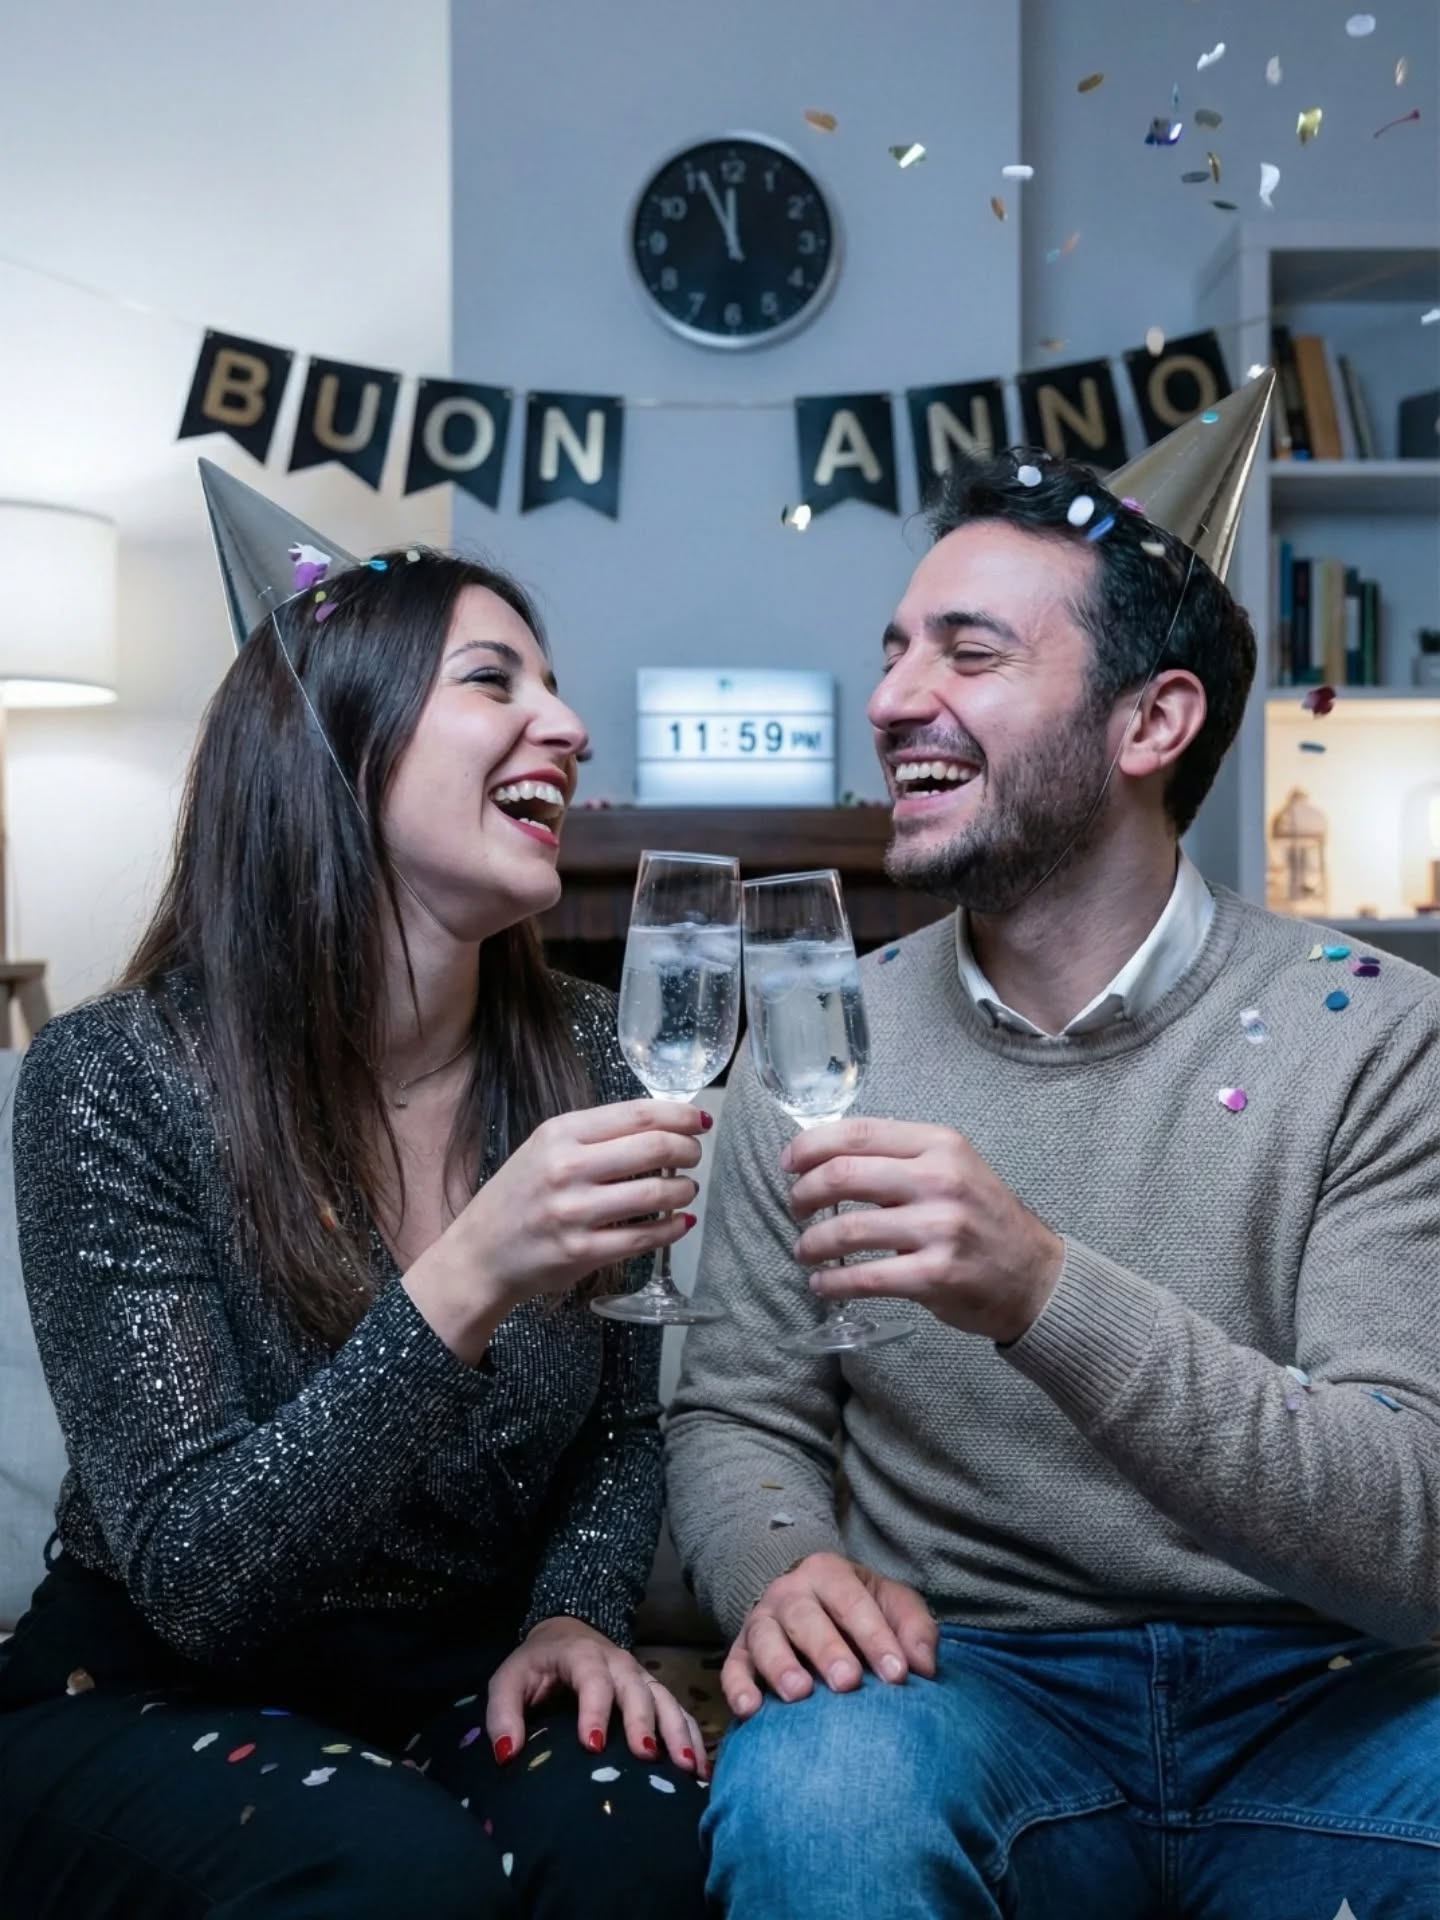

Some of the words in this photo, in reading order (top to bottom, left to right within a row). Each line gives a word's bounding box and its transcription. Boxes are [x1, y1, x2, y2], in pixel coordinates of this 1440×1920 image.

[720, 159, 745, 183] 12
[765, 170, 775, 193] 1
[659, 196, 687, 221] 10
[787, 196, 804, 220] 2
[649, 230, 667, 256] 9
[799, 229, 816, 255] 3
[660, 267, 679, 292] 8
[787, 266, 804, 287] 4
[688, 291, 705, 317] 7
[723, 302, 743, 327] 6
[760, 291, 777, 316] 5
[202, 347, 606, 485] BUON
[813, 353, 1219, 487] ANNO
[669, 721, 783, 753] 11:59
